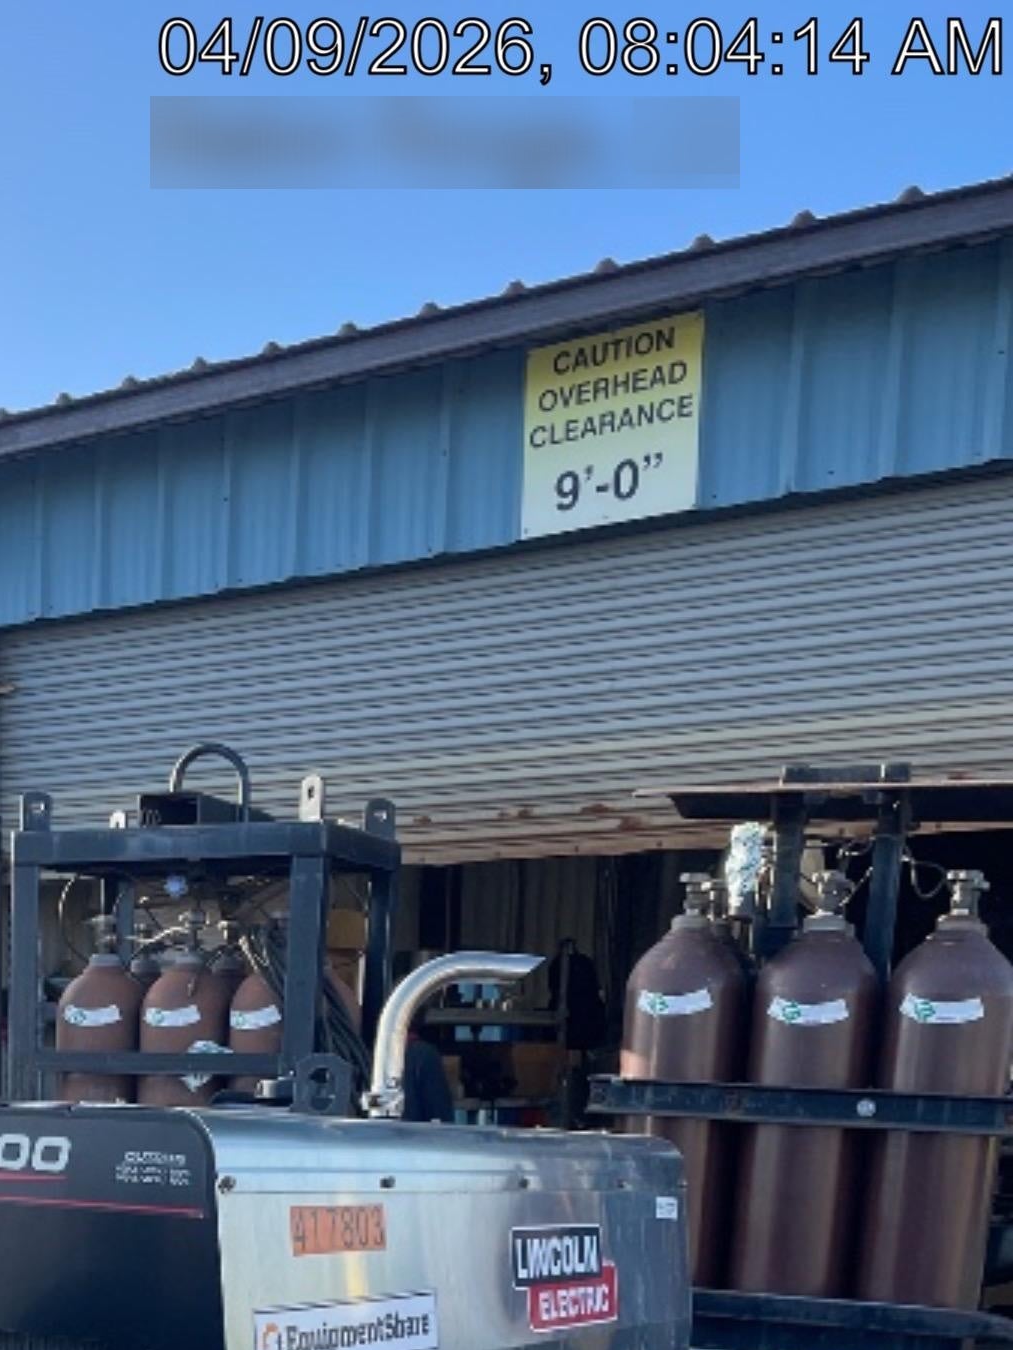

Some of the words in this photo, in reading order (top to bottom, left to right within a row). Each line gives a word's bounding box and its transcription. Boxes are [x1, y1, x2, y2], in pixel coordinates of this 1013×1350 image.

[553, 327, 675, 375] CAUTION
[538, 360, 687, 413] OVERHEAD
[529, 394, 693, 449] CLEARANCE
[290, 1205, 385, 1252] 417803
[515, 1235, 599, 1279] LINCOLN
[539, 1283, 609, 1321] ELECTRIC
